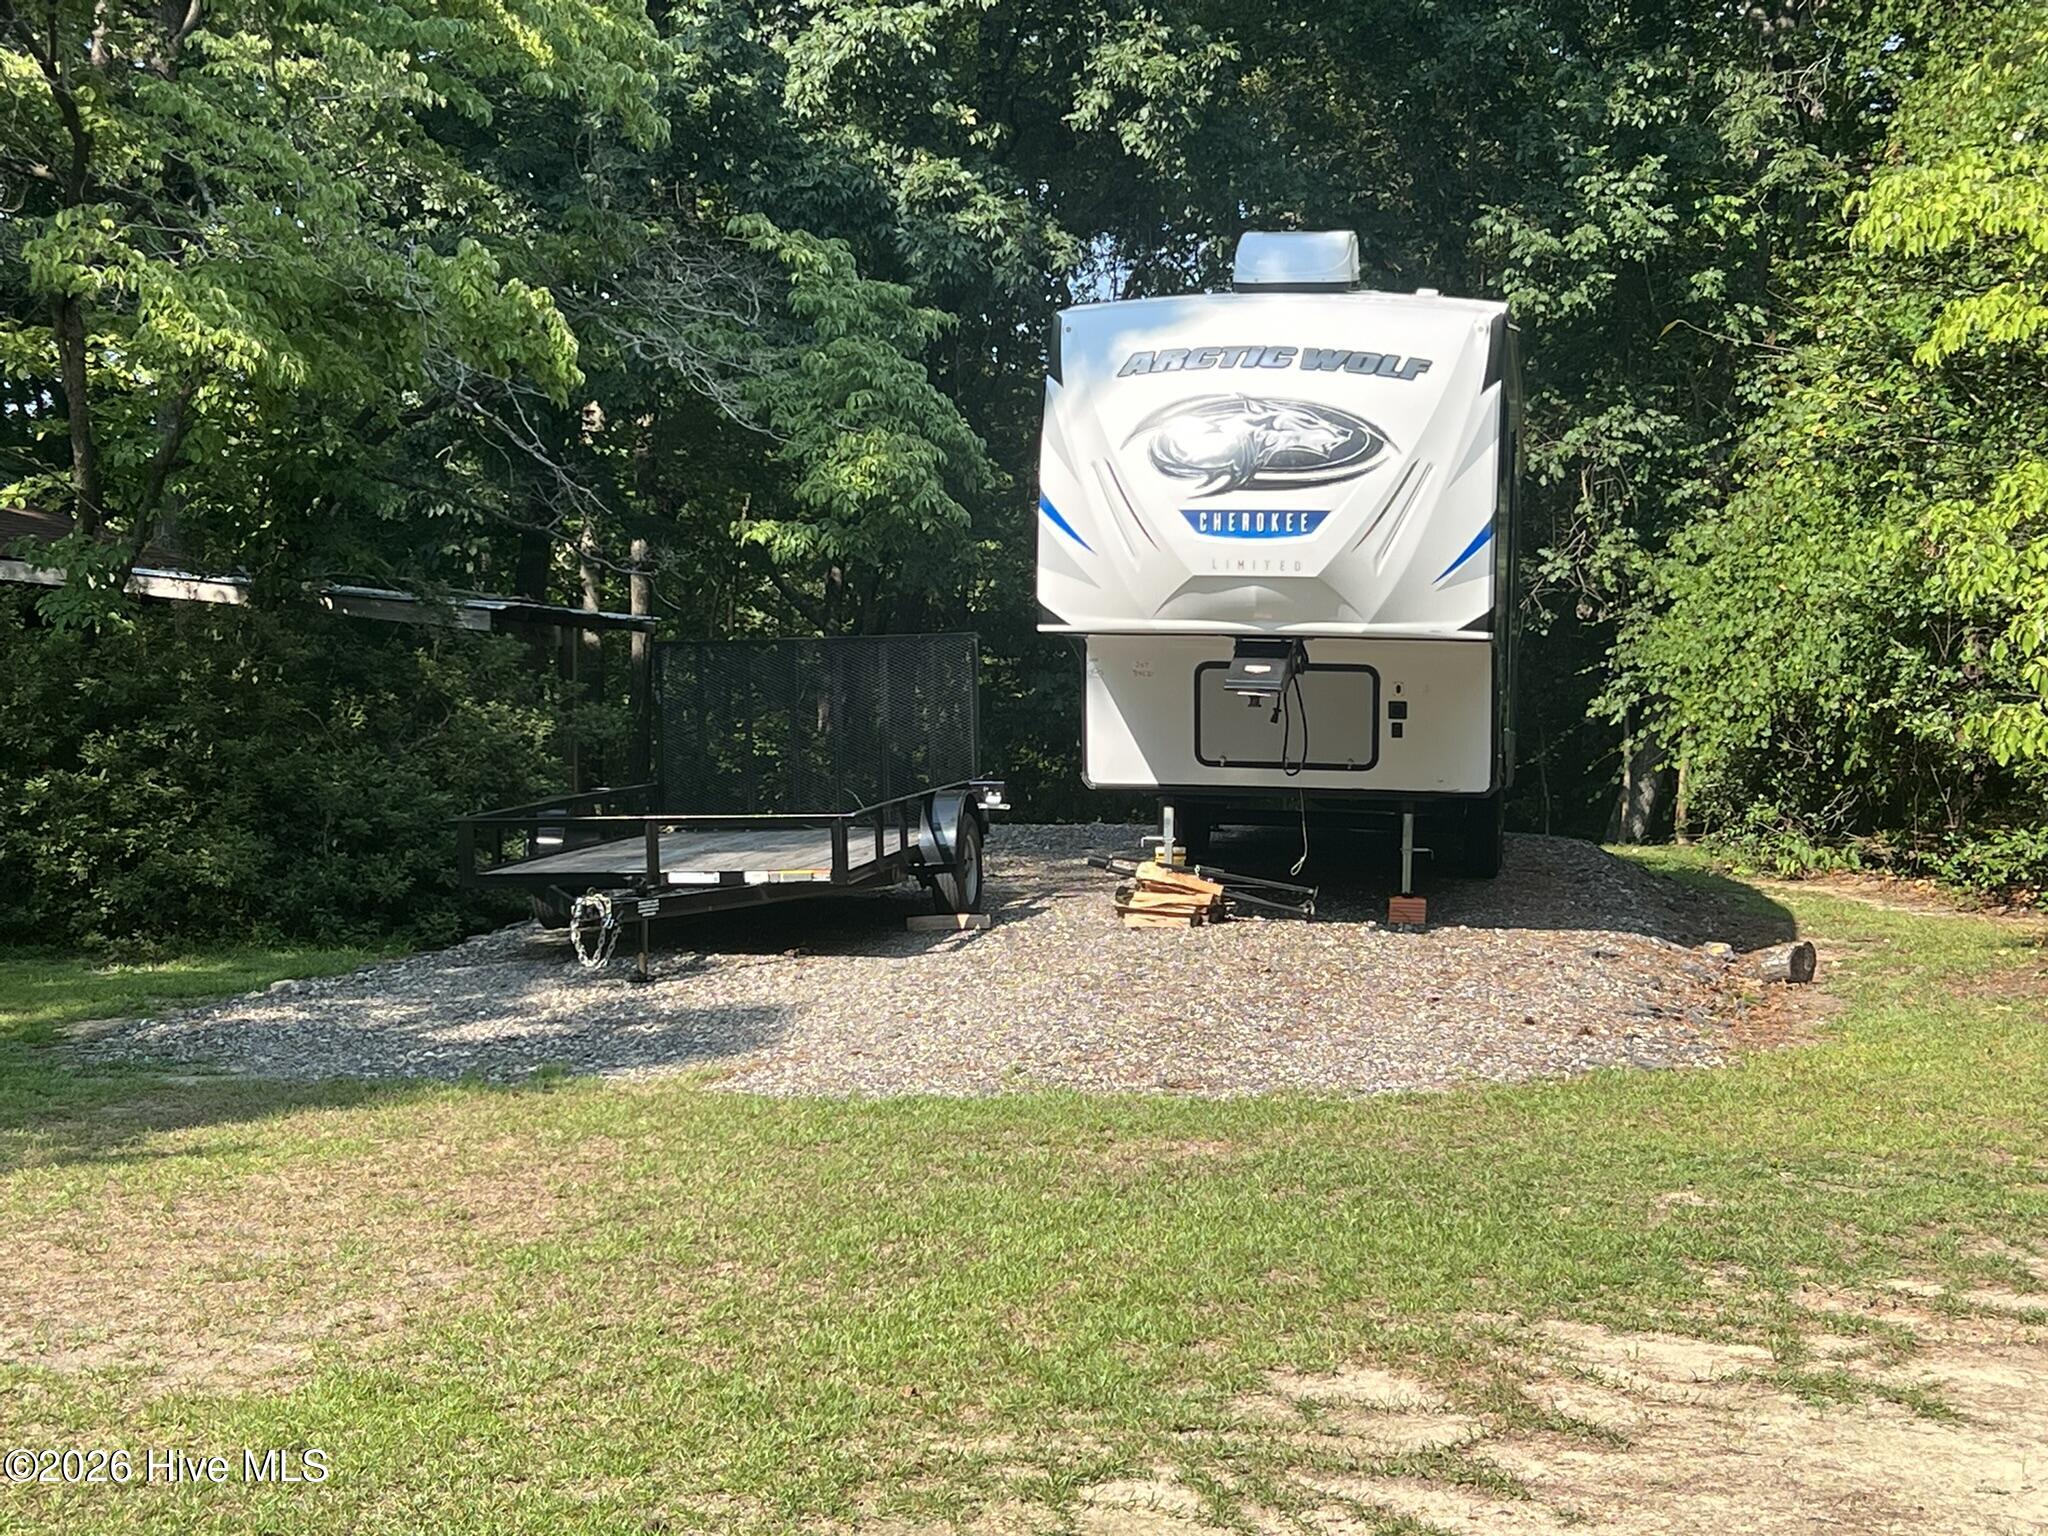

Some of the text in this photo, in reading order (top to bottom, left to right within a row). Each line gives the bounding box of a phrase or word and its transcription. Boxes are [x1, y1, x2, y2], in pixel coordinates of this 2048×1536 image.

[1117, 345, 1433, 381] ARCTIC WOLF
[1199, 511, 1309, 533] CHEROKEE
[1211, 558, 1303, 572] LIMITED
